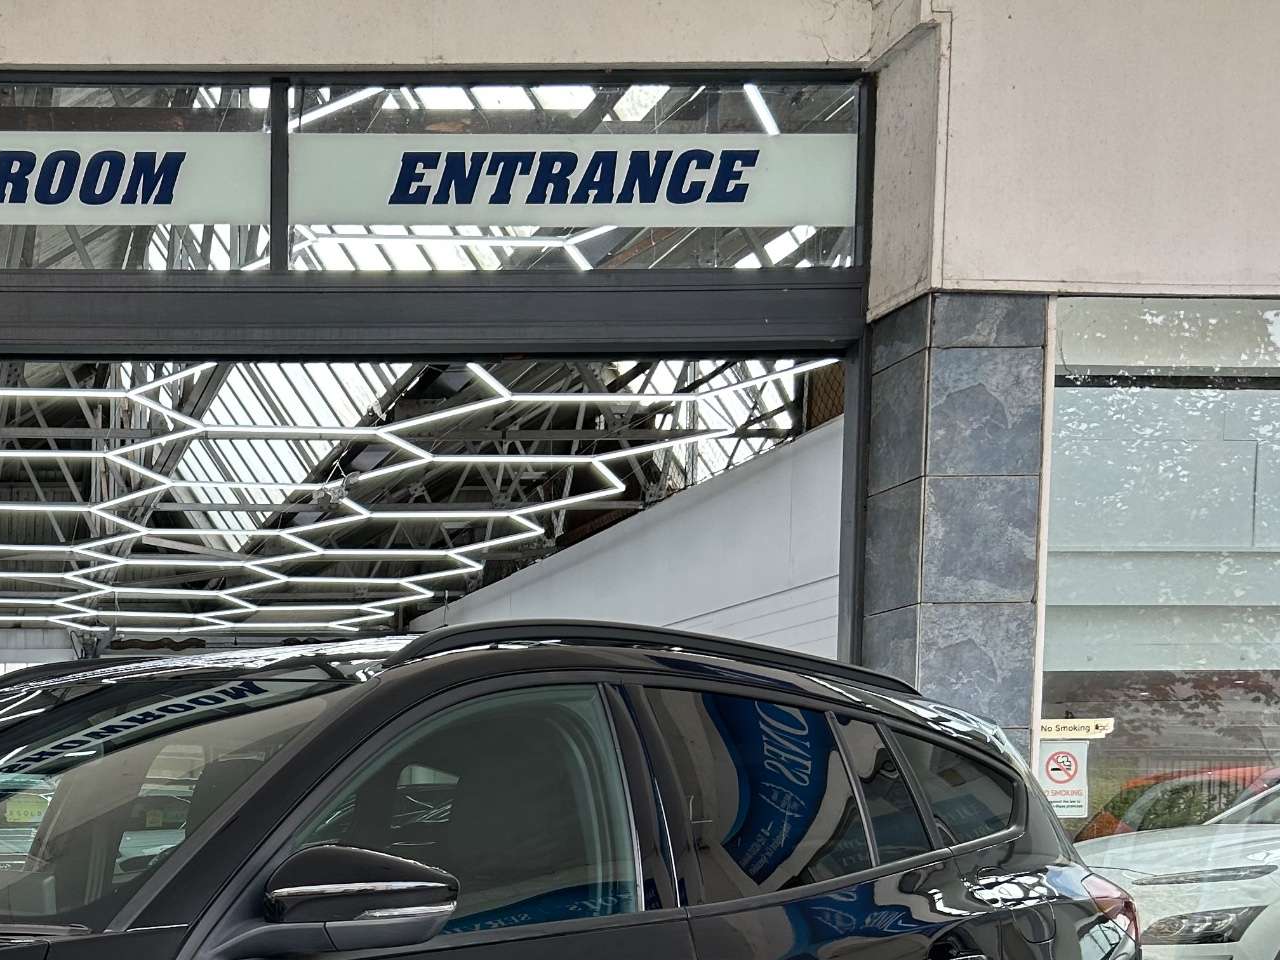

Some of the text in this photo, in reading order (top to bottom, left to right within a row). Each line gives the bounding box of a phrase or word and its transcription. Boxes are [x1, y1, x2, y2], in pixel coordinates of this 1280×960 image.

[388, 149, 761, 206] ENTRANCE
[1040, 724, 1091, 733] No Smoking
